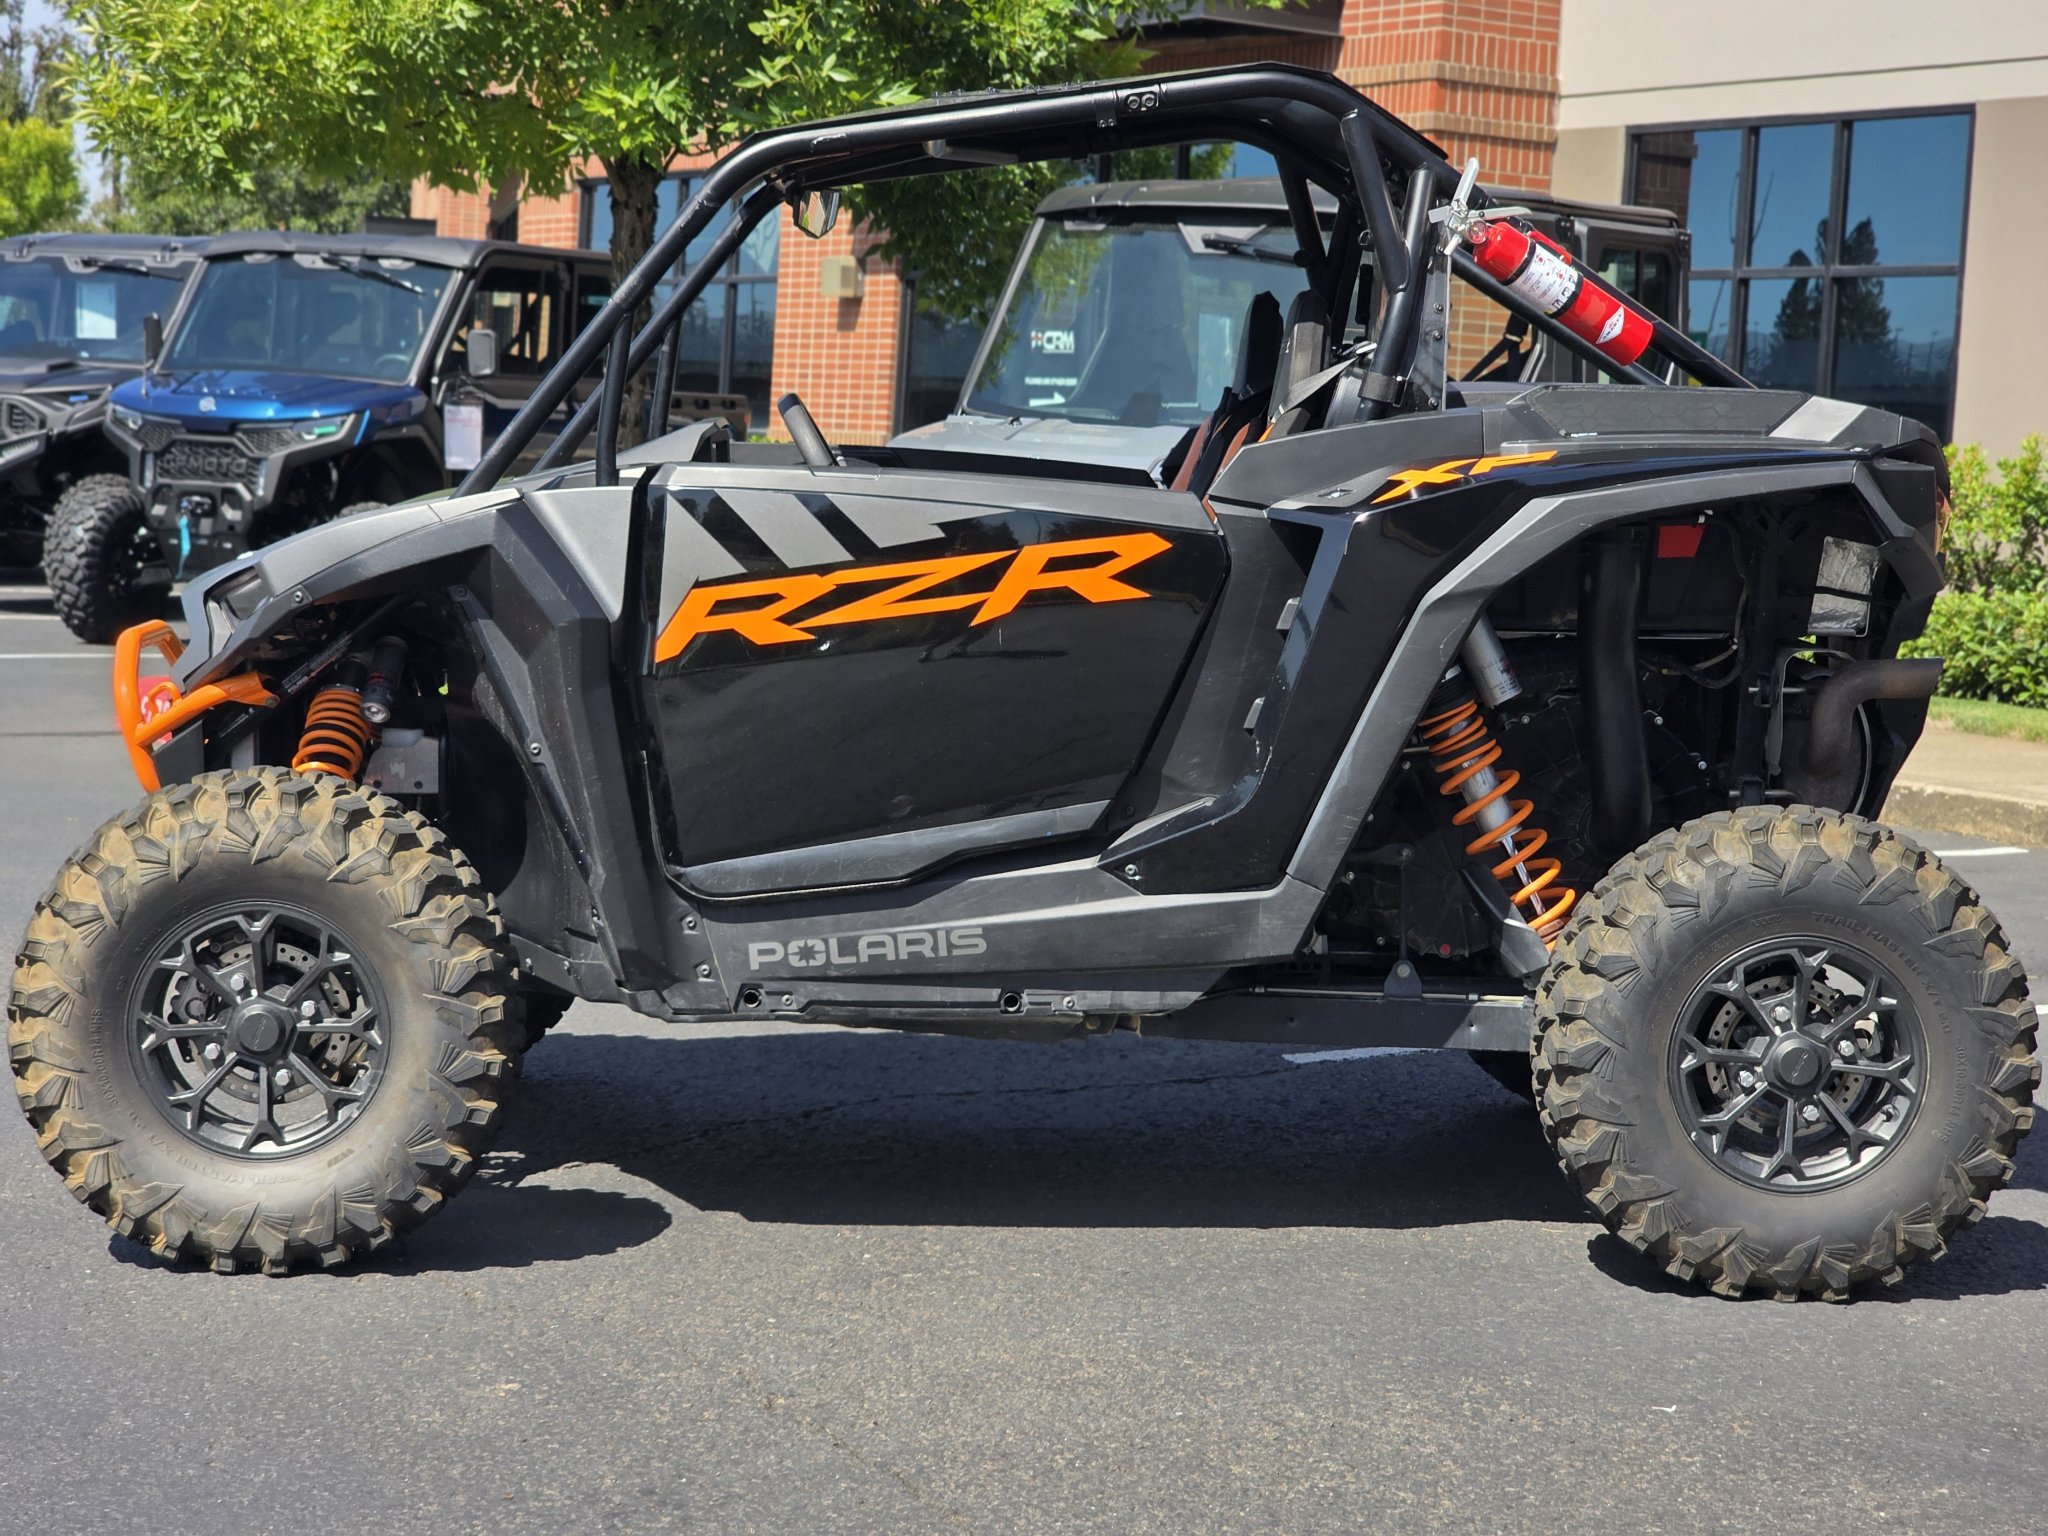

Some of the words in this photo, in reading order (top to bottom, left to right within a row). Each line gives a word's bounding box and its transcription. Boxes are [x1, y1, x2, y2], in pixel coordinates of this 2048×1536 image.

[1371, 451, 1558, 504] XP
[656, 532, 1172, 663] RZR
[749, 928, 987, 970] POLARIS
